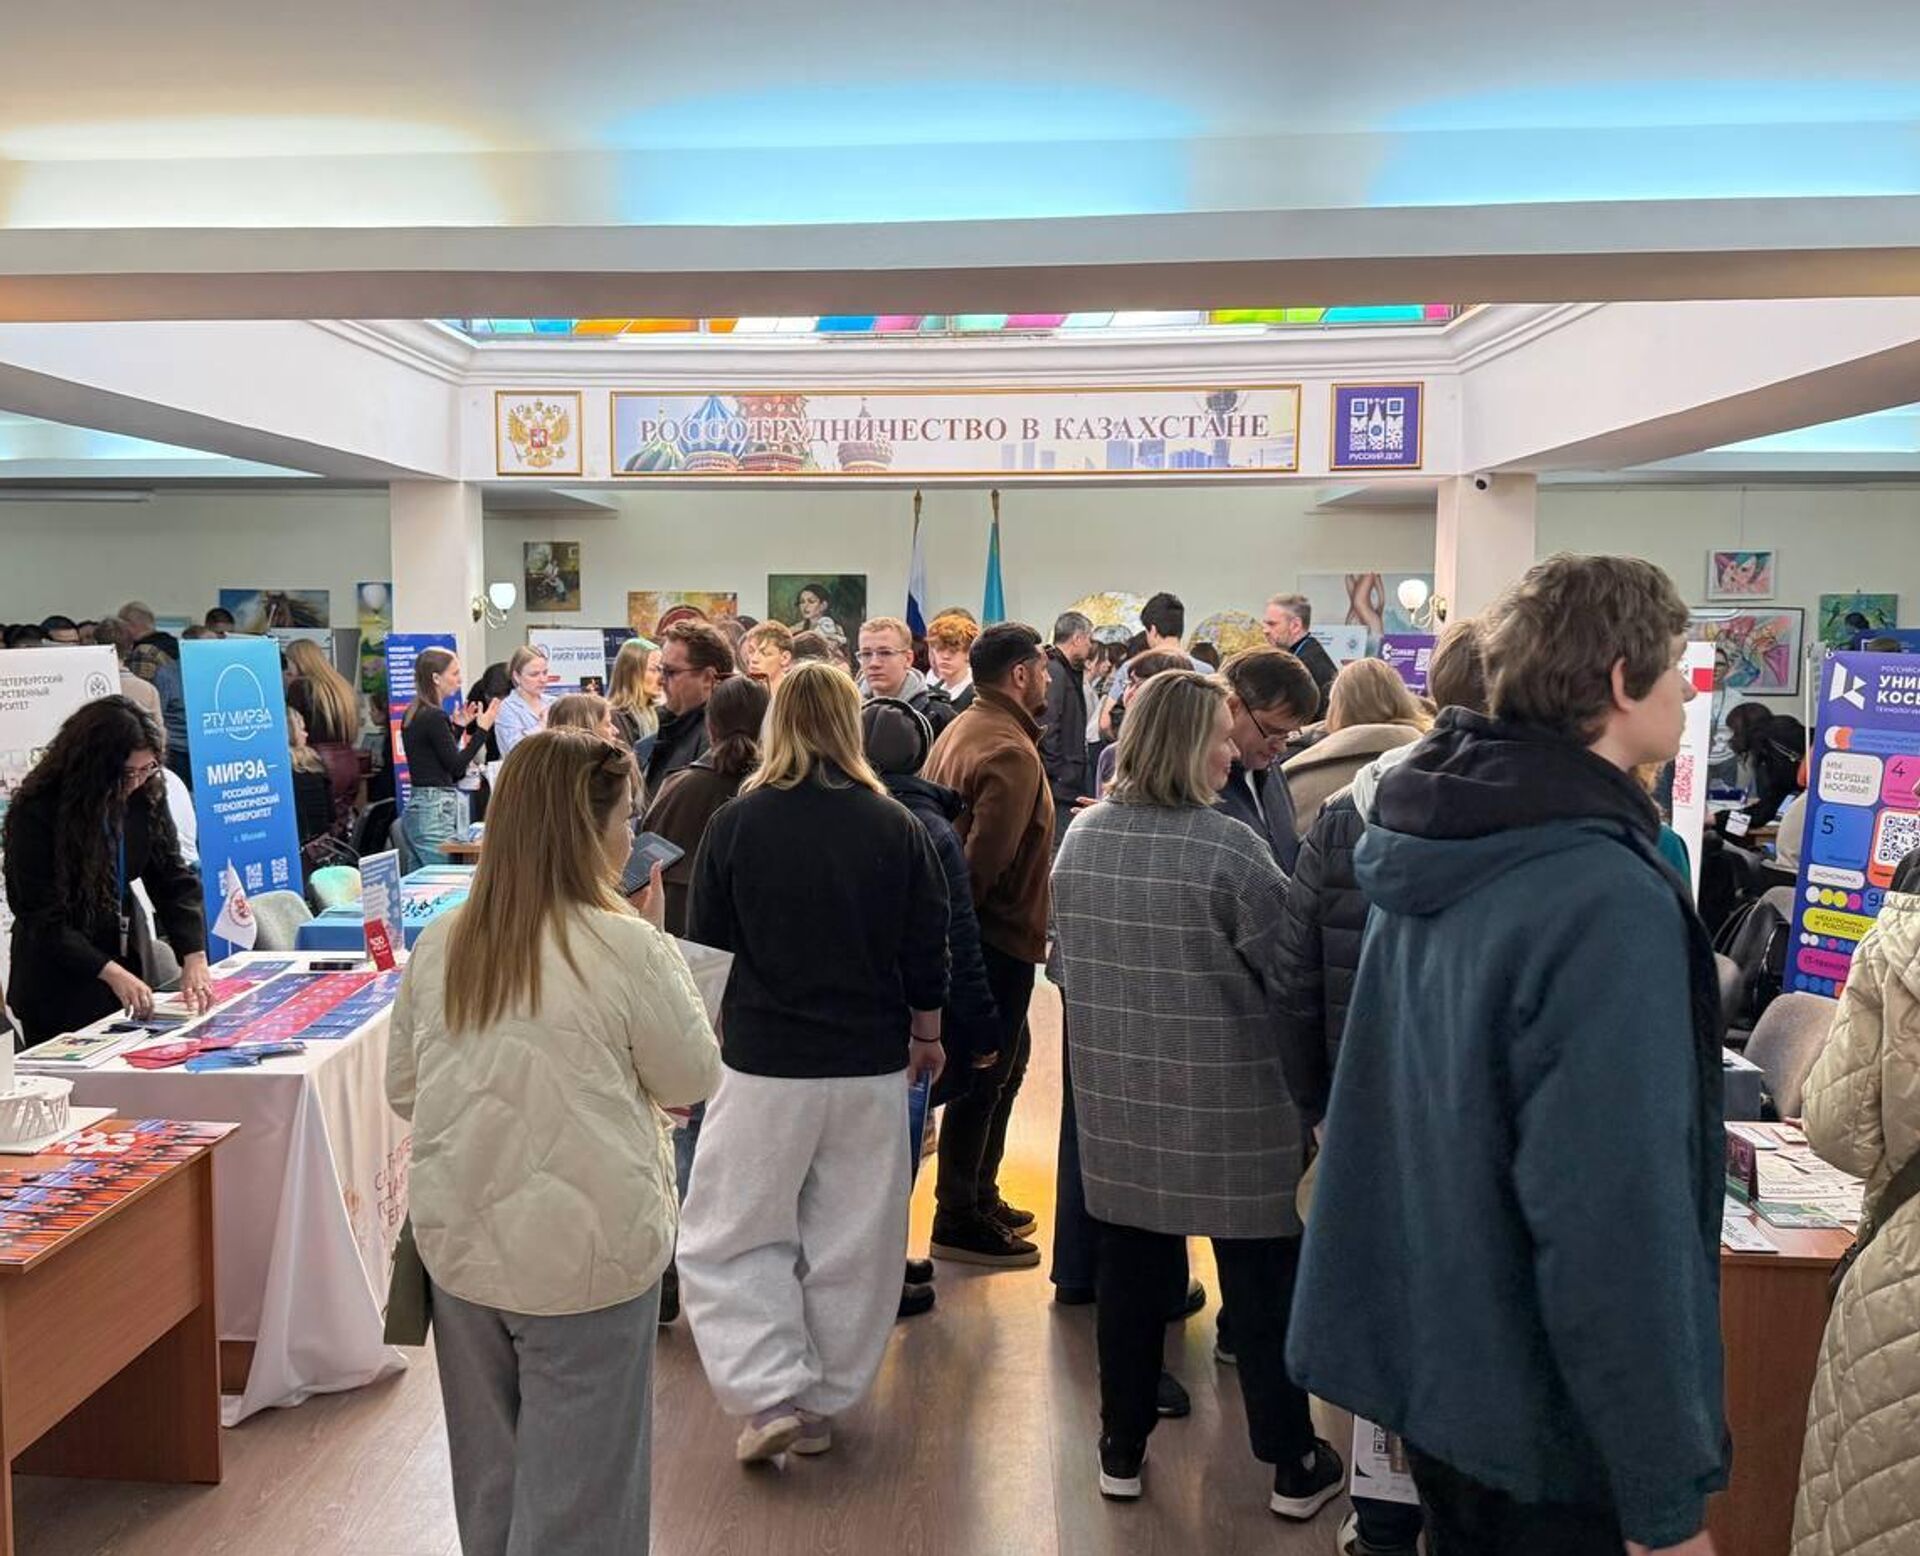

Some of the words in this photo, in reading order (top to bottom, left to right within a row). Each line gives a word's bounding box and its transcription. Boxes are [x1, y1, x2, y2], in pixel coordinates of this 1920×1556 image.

[641, 417, 1007, 443] РОССОТРУДНИЧЕСТВО
[1022, 418, 1040, 440] В
[1055, 414, 1269, 440] КАЗАХСТАНЕ
[1385, 451, 1403, 460] ДОМ
[203, 711, 226, 728] РТУ
[228, 707, 272, 726] МИРЭА
[1833, 772, 1871, 784] СЕРДЦЕ
[1892, 760, 1906, 778] 4
[221, 782, 270, 799] РОССИЙСКИЙ
[213, 793, 280, 814] ТЕХНОЛОГИЧЕСКИЙ
[224, 806, 272, 824] УНИВЕРСИТЕТ
[1821, 814, 1835, 835] 5
